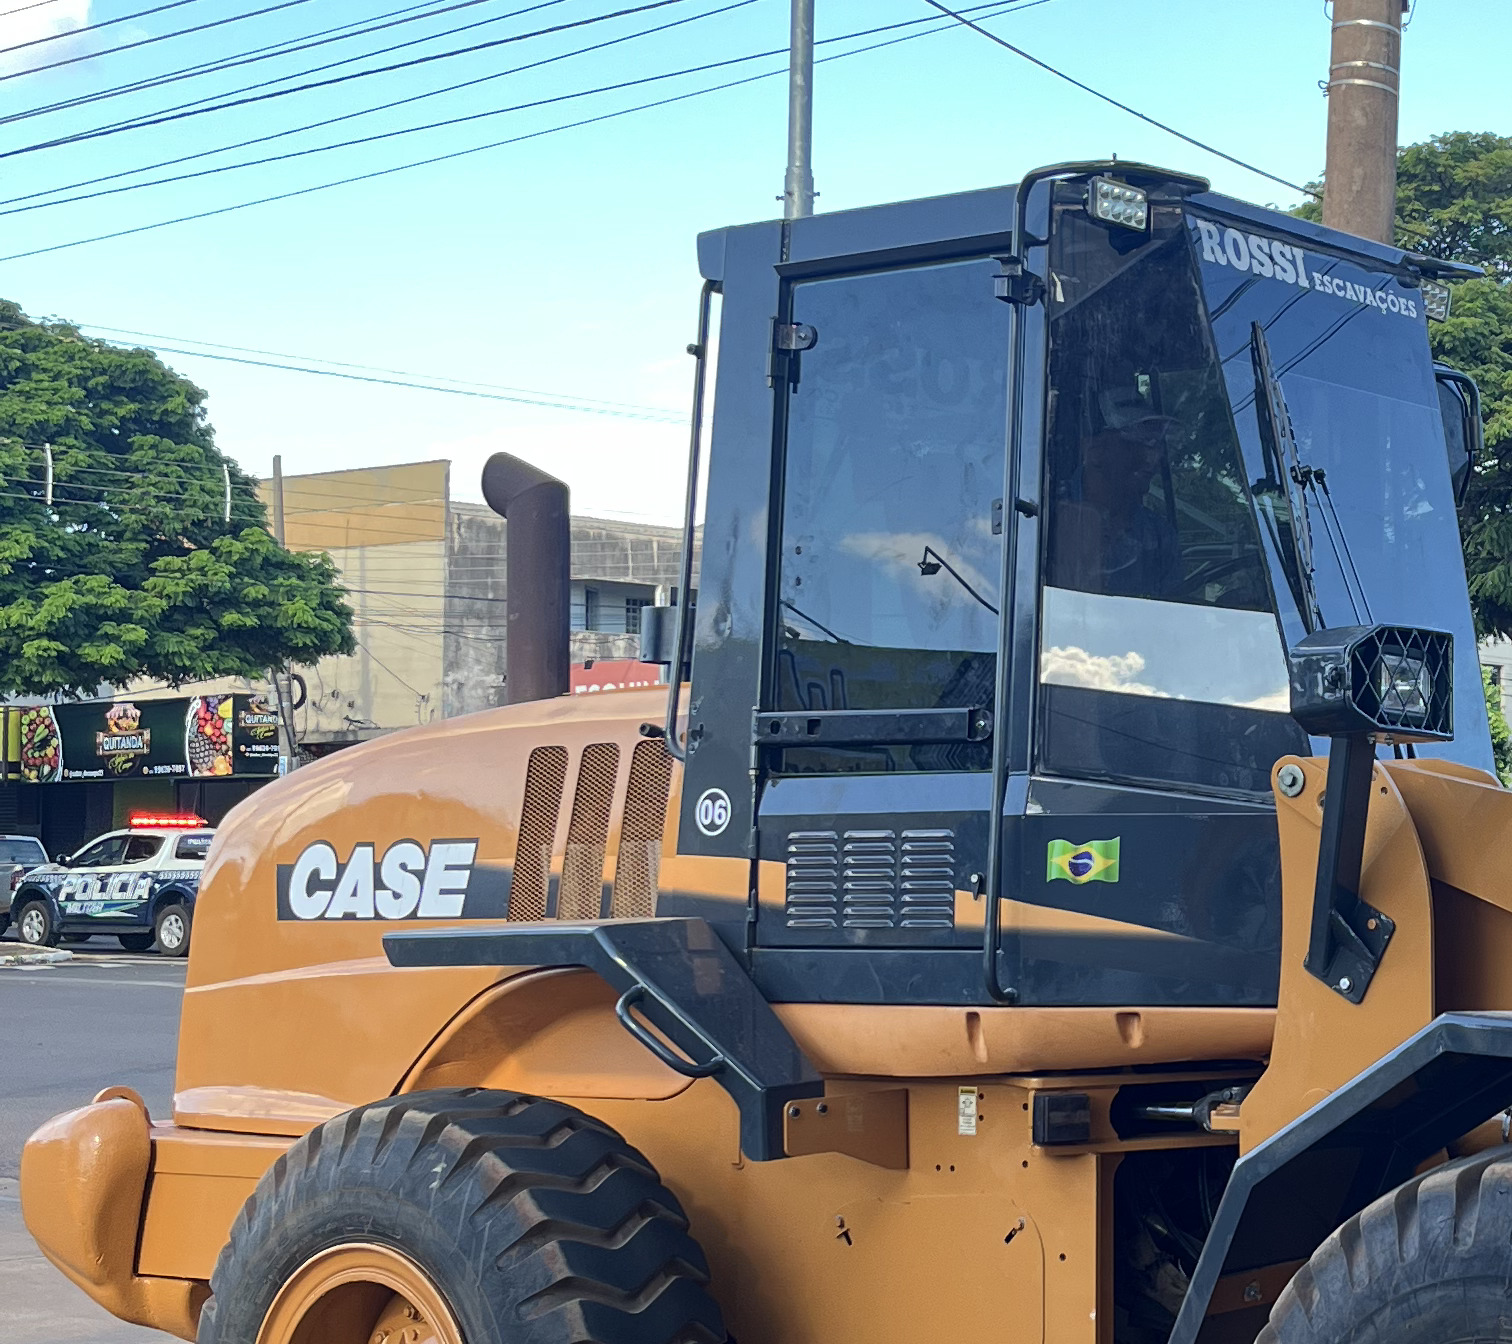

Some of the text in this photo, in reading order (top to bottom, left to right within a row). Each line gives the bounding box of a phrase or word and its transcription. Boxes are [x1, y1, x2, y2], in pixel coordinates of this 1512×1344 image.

[1196, 219, 1418, 319] ROSSI ESCAVAÇÕES
[245, 714, 278, 724] QUITAND
[103, 736, 144, 751] QUITANDA
[700, 798, 728, 826] 06
[288, 842, 478, 920] CASE
